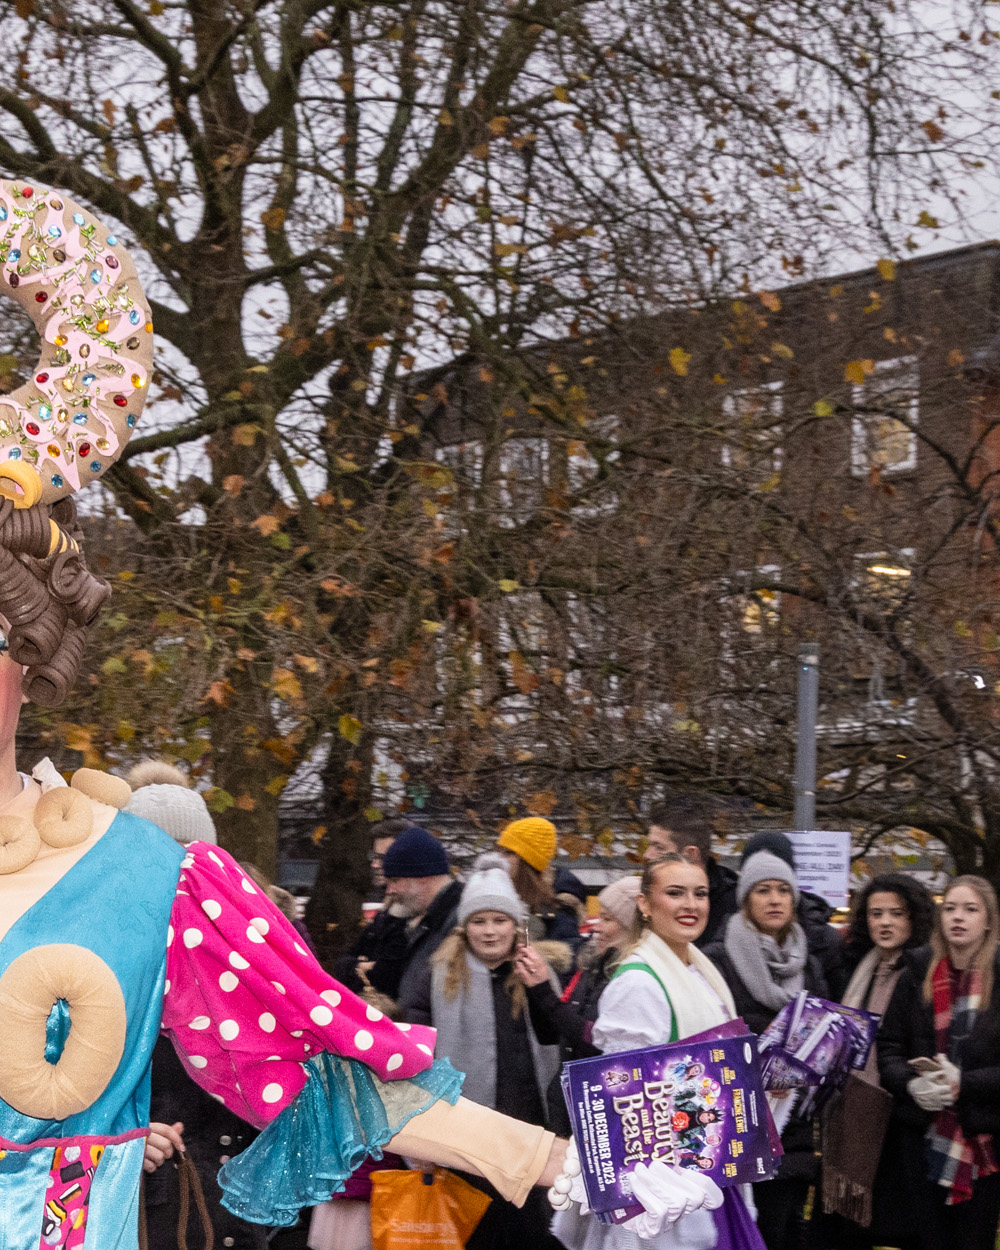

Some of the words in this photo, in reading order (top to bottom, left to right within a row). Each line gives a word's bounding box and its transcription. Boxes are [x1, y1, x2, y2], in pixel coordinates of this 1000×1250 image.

[590, 1084, 603, 1092] 9
[591, 1098, 605, 1112] 30
[732, 1088, 743, 1116] FRANCINE
[612, 1092, 648, 1165] Beast
[640, 1108, 652, 1127] and
[644, 1080, 677, 1163] Beauty
[735, 1116, 745, 1134] LEWIS
[593, 1112, 612, 1160] DECEMBER
[641, 1128, 656, 1145] the
[601, 1160, 616, 1185] 2023
